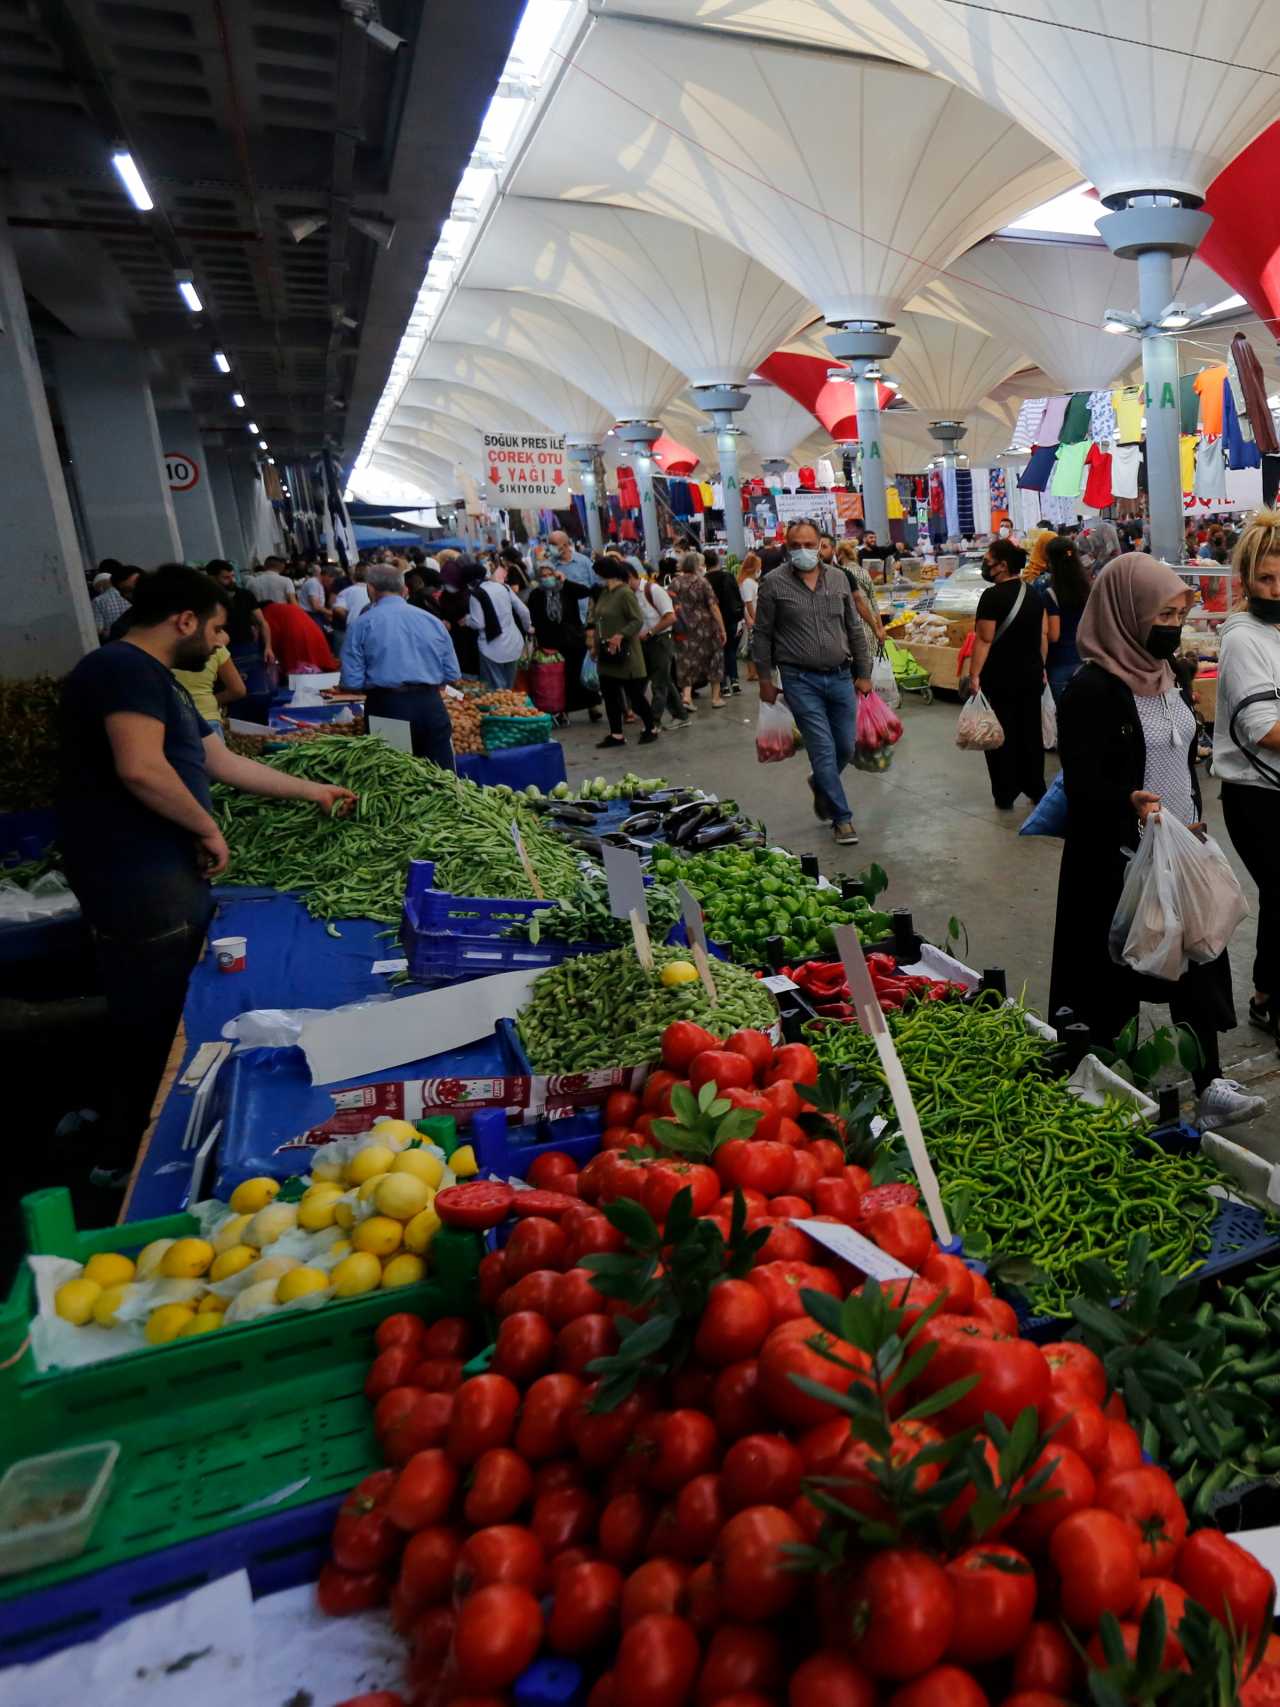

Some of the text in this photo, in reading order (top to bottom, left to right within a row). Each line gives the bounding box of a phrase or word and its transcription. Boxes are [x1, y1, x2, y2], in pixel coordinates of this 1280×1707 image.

[484, 432, 519, 448] SOĞUK
[521, 437, 547, 449] PRES
[538, 452, 562, 465] OTU
[166, 463, 189, 481] 10
[508, 464, 545, 483] YAĞI
[499, 483, 557, 495] SIKIYORUZ
[727, 476, 737, 489] A
